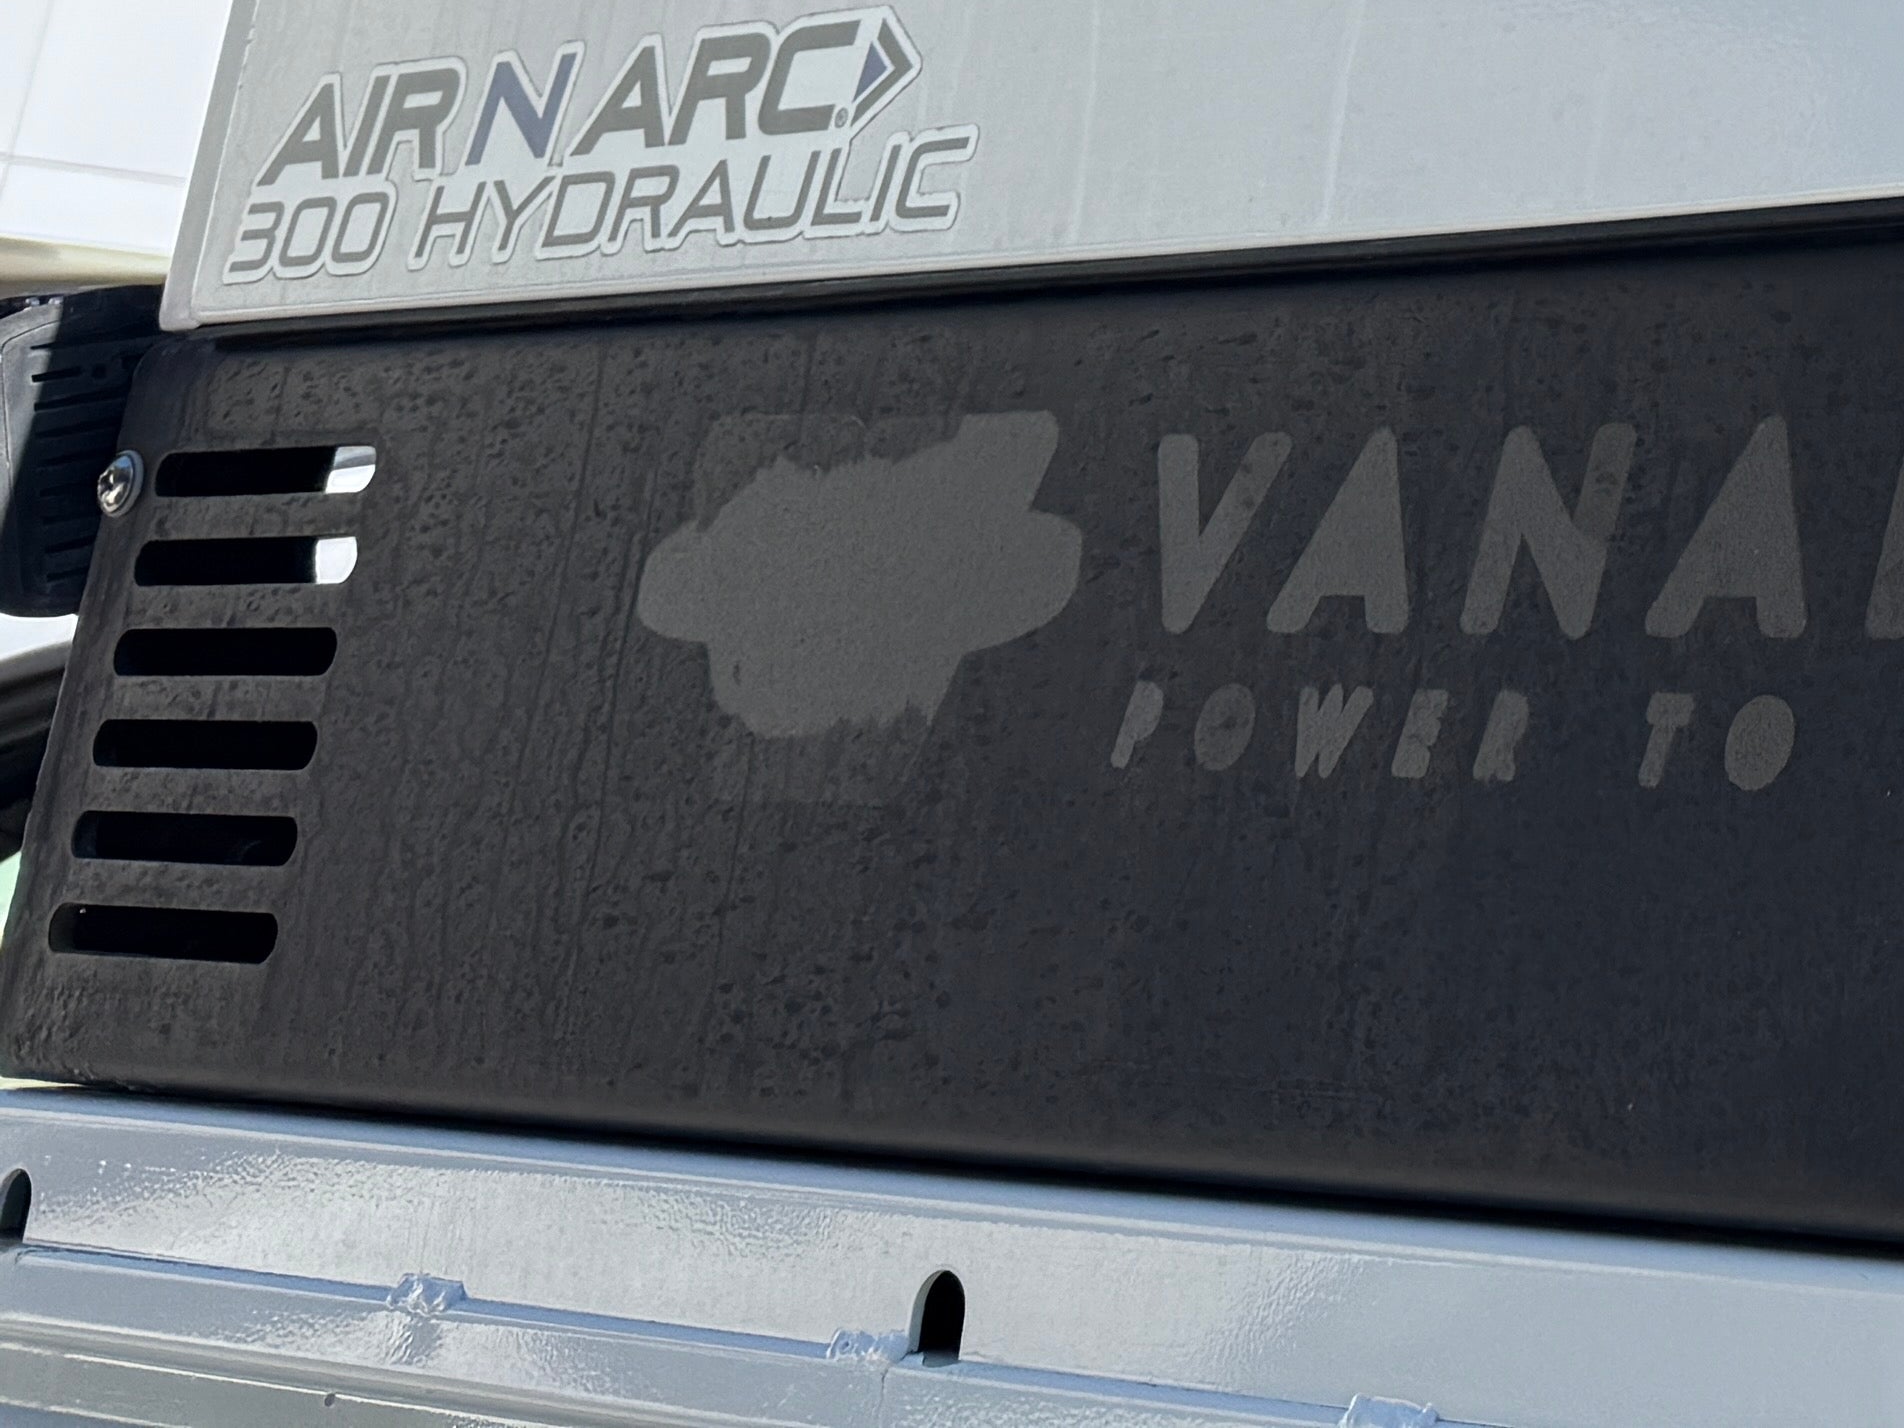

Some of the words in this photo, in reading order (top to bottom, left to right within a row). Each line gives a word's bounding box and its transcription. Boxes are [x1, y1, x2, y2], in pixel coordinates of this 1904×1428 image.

[228, 196, 392, 274] 300
[415, 138, 969, 260] HYDRAULIC
[1637, 690, 1796, 792] TO
